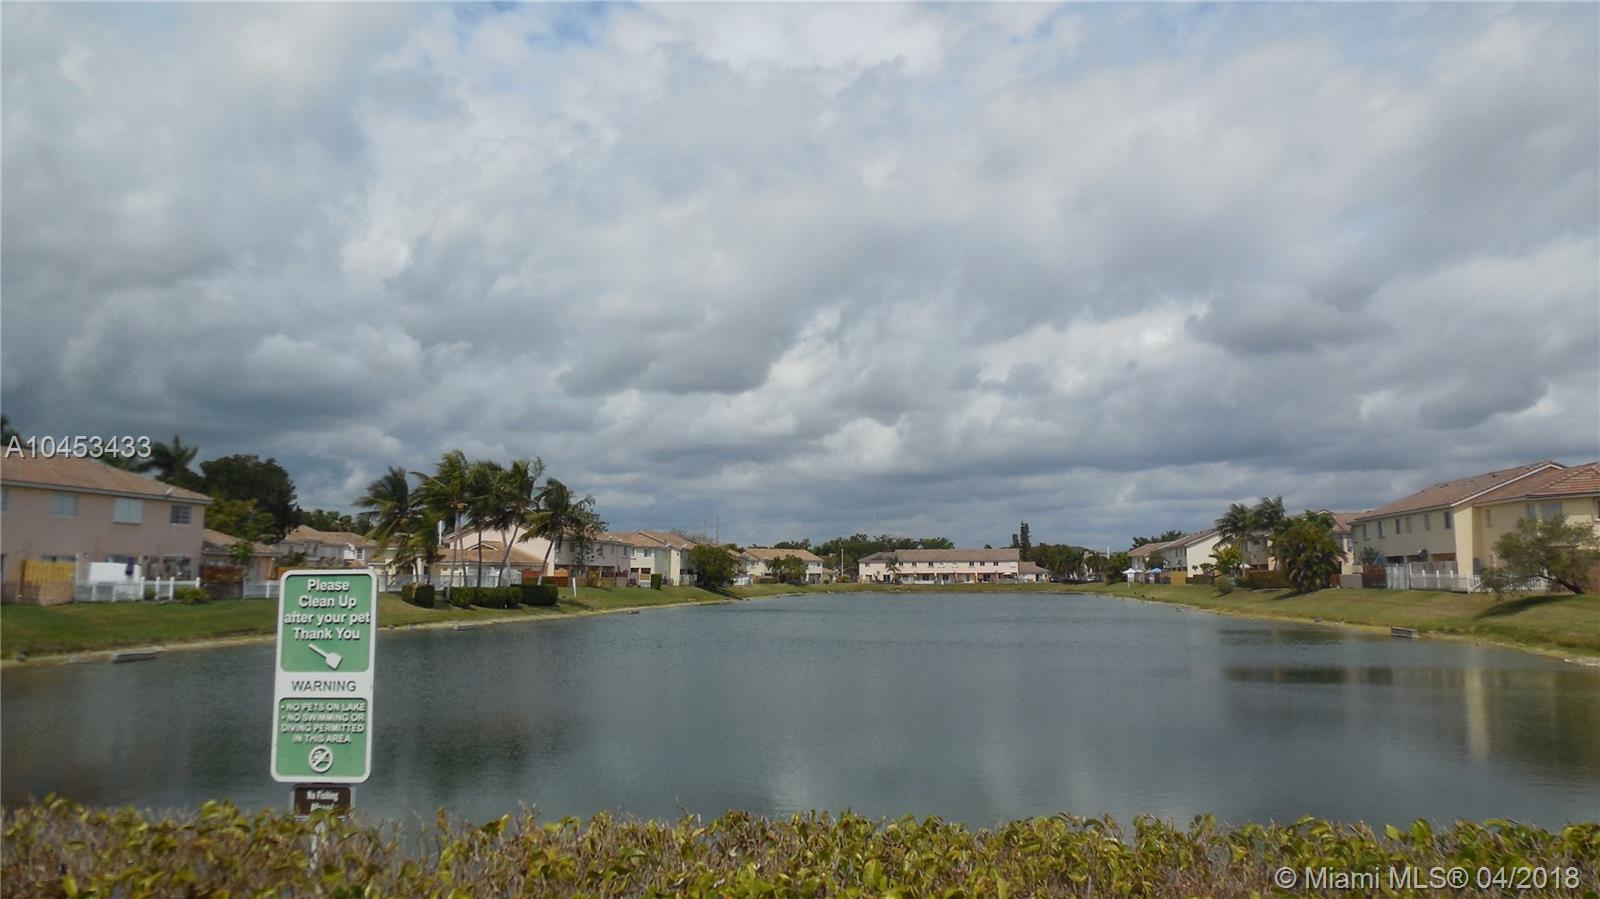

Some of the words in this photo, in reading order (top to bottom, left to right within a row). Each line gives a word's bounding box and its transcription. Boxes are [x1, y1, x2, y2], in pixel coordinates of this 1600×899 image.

[307, 580, 349, 592] Please
[298, 596, 335, 608] Clean
[339, 596, 357, 609] Up
[283, 612, 313, 624] after
[316, 613, 346, 627] your
[349, 612, 371, 625] pet
[293, 628, 332, 640] Thank
[336, 628, 360, 640] You
[291, 680, 357, 692] WARNING
[286, 703, 300, 711] NO
[301, 703, 325, 712] PETS
[326, 703, 340, 711] ON
[341, 703, 366, 712] LAKE
[286, 714, 300, 722] NO
[302, 714, 349, 722] SWIMMING
[350, 714, 365, 722] OR
[281, 724, 312, 733] DIVING
[313, 724, 365, 733] PERMITTED
